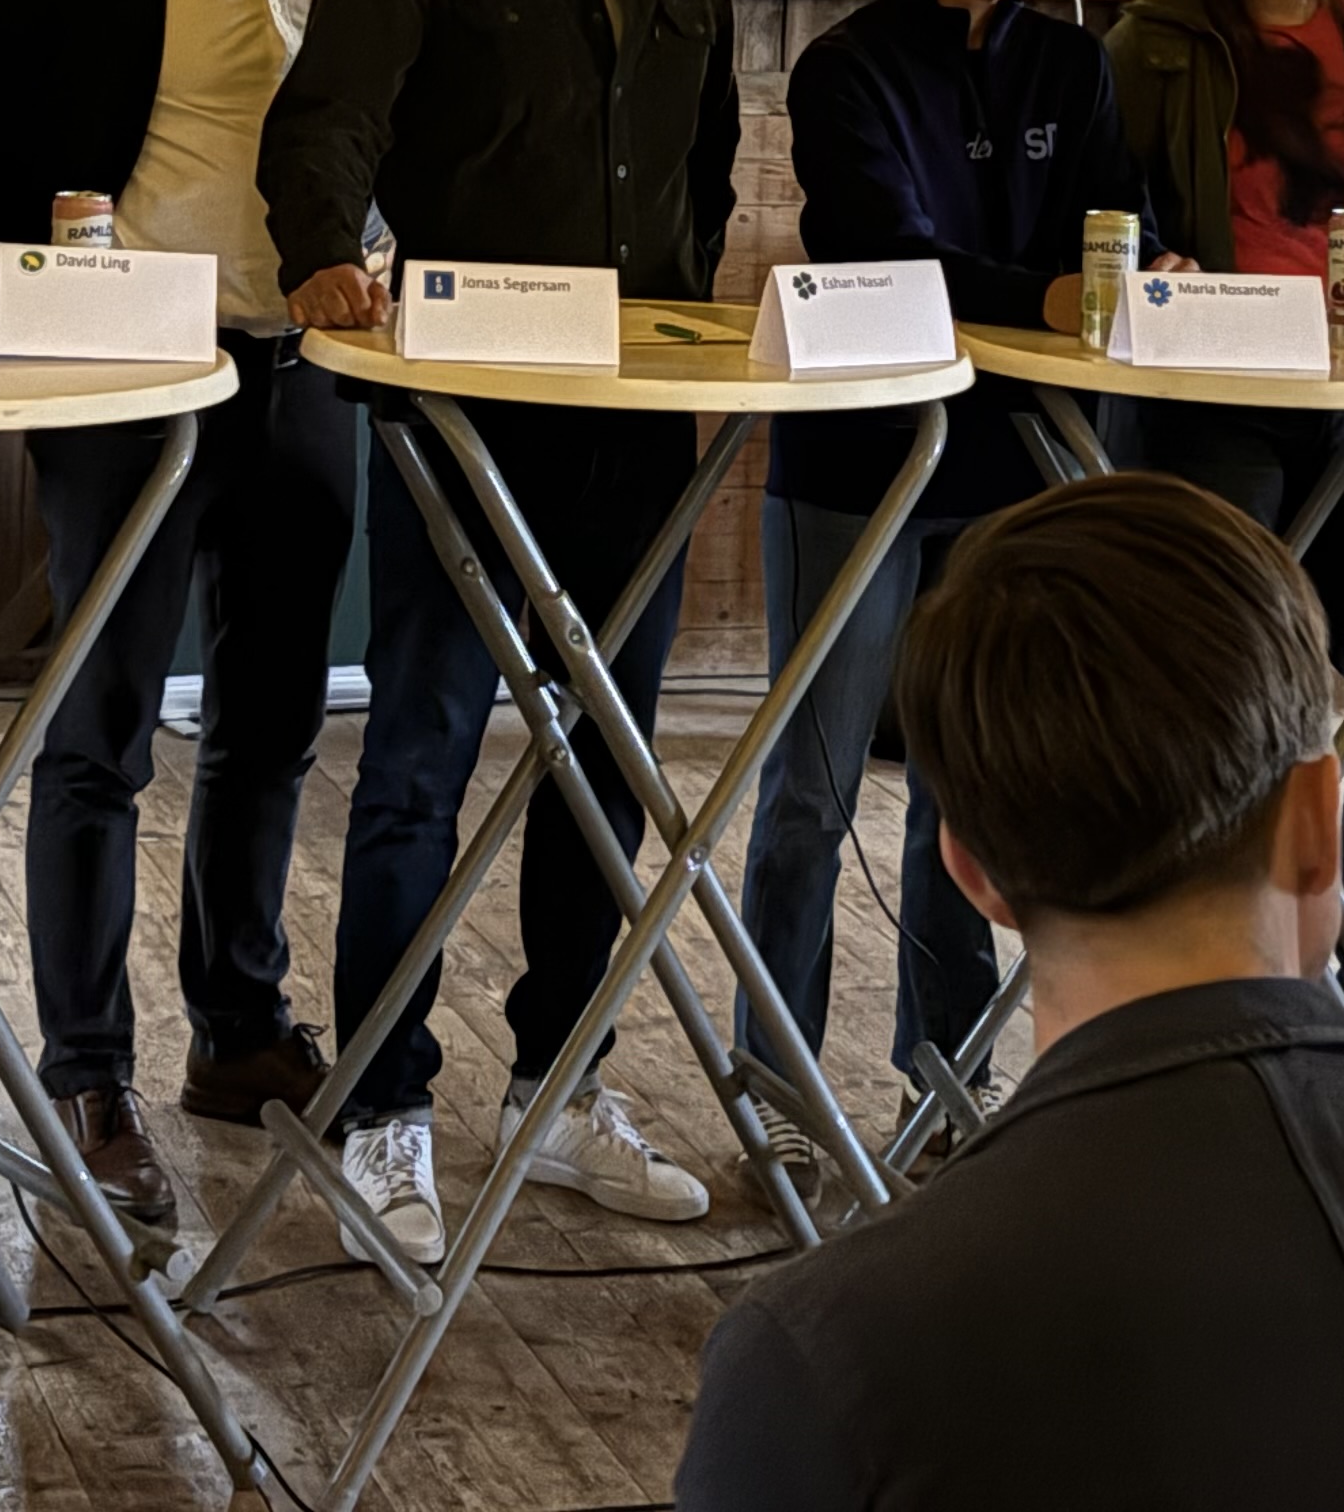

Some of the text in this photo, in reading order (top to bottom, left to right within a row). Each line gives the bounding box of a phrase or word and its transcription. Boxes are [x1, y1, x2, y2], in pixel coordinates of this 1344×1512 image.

[56, 253, 130, 273] David Ling
[461, 275, 500, 289] Jonas
[503, 276, 571, 293] Segersam
[1177, 282, 1281, 297] Maria Rosander
